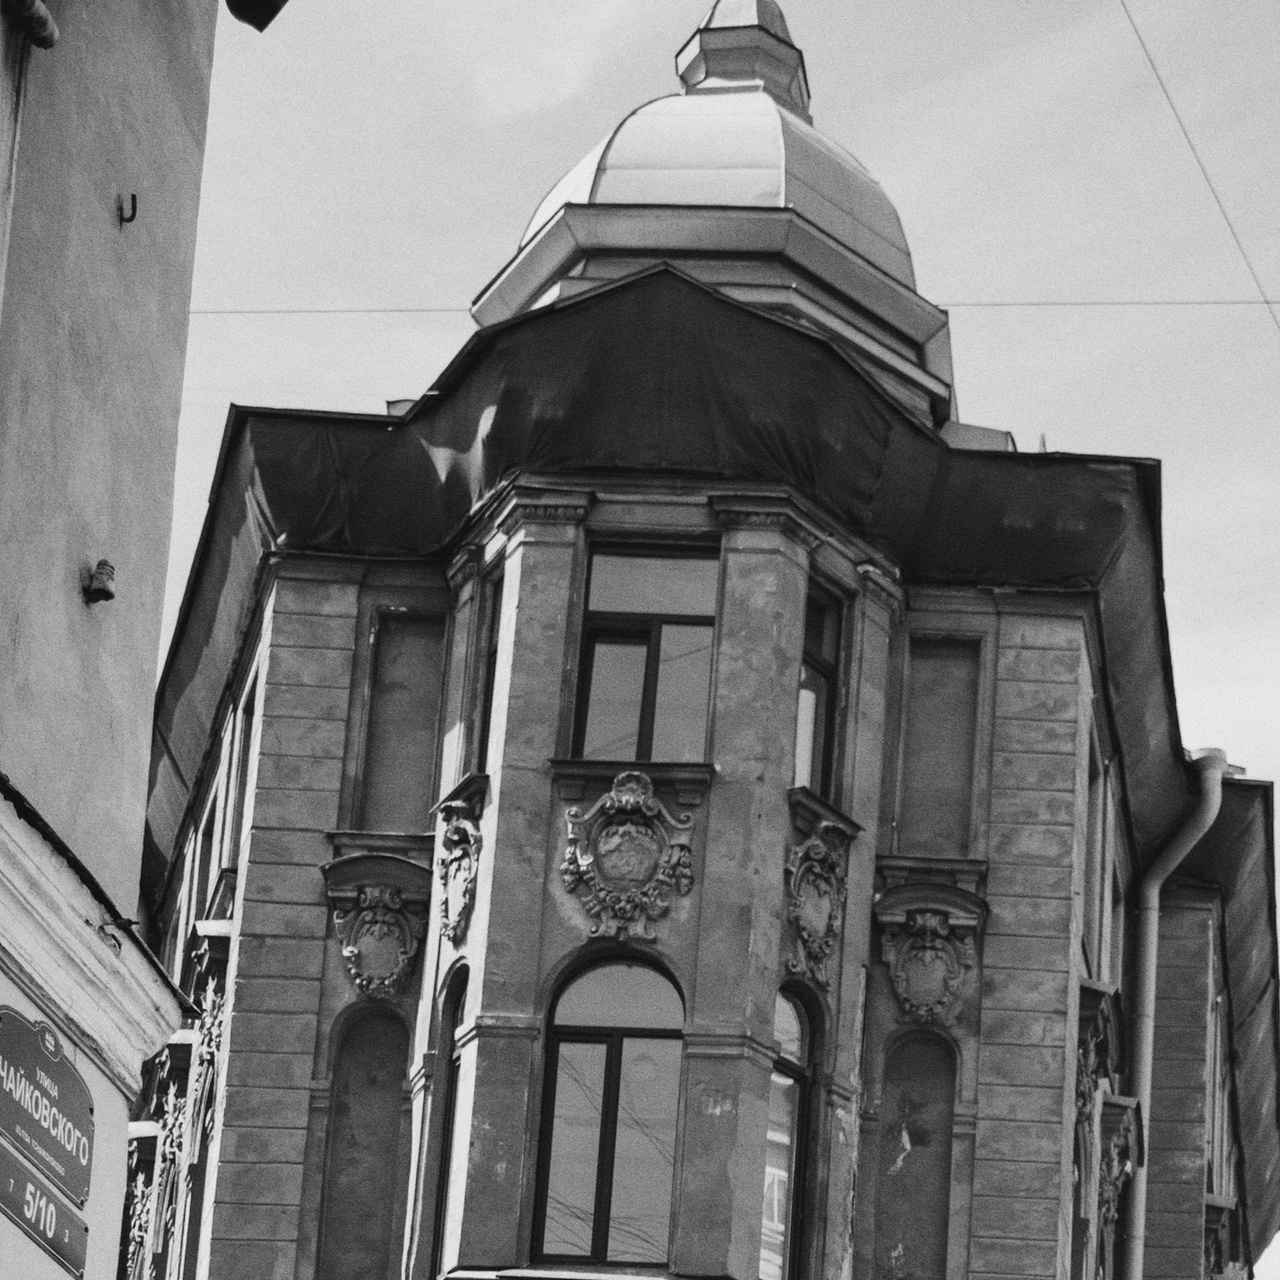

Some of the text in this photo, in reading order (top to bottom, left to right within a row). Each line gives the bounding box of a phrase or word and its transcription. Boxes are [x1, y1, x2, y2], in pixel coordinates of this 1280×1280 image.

[0, 1055, 89, 1166] ЧАЙКОВСКОГО
[36, 1067, 59, 1100] УЛИЦА
[24, 1182, 57, 1239] 5/10
[63, 1229, 69, 1243] 3
